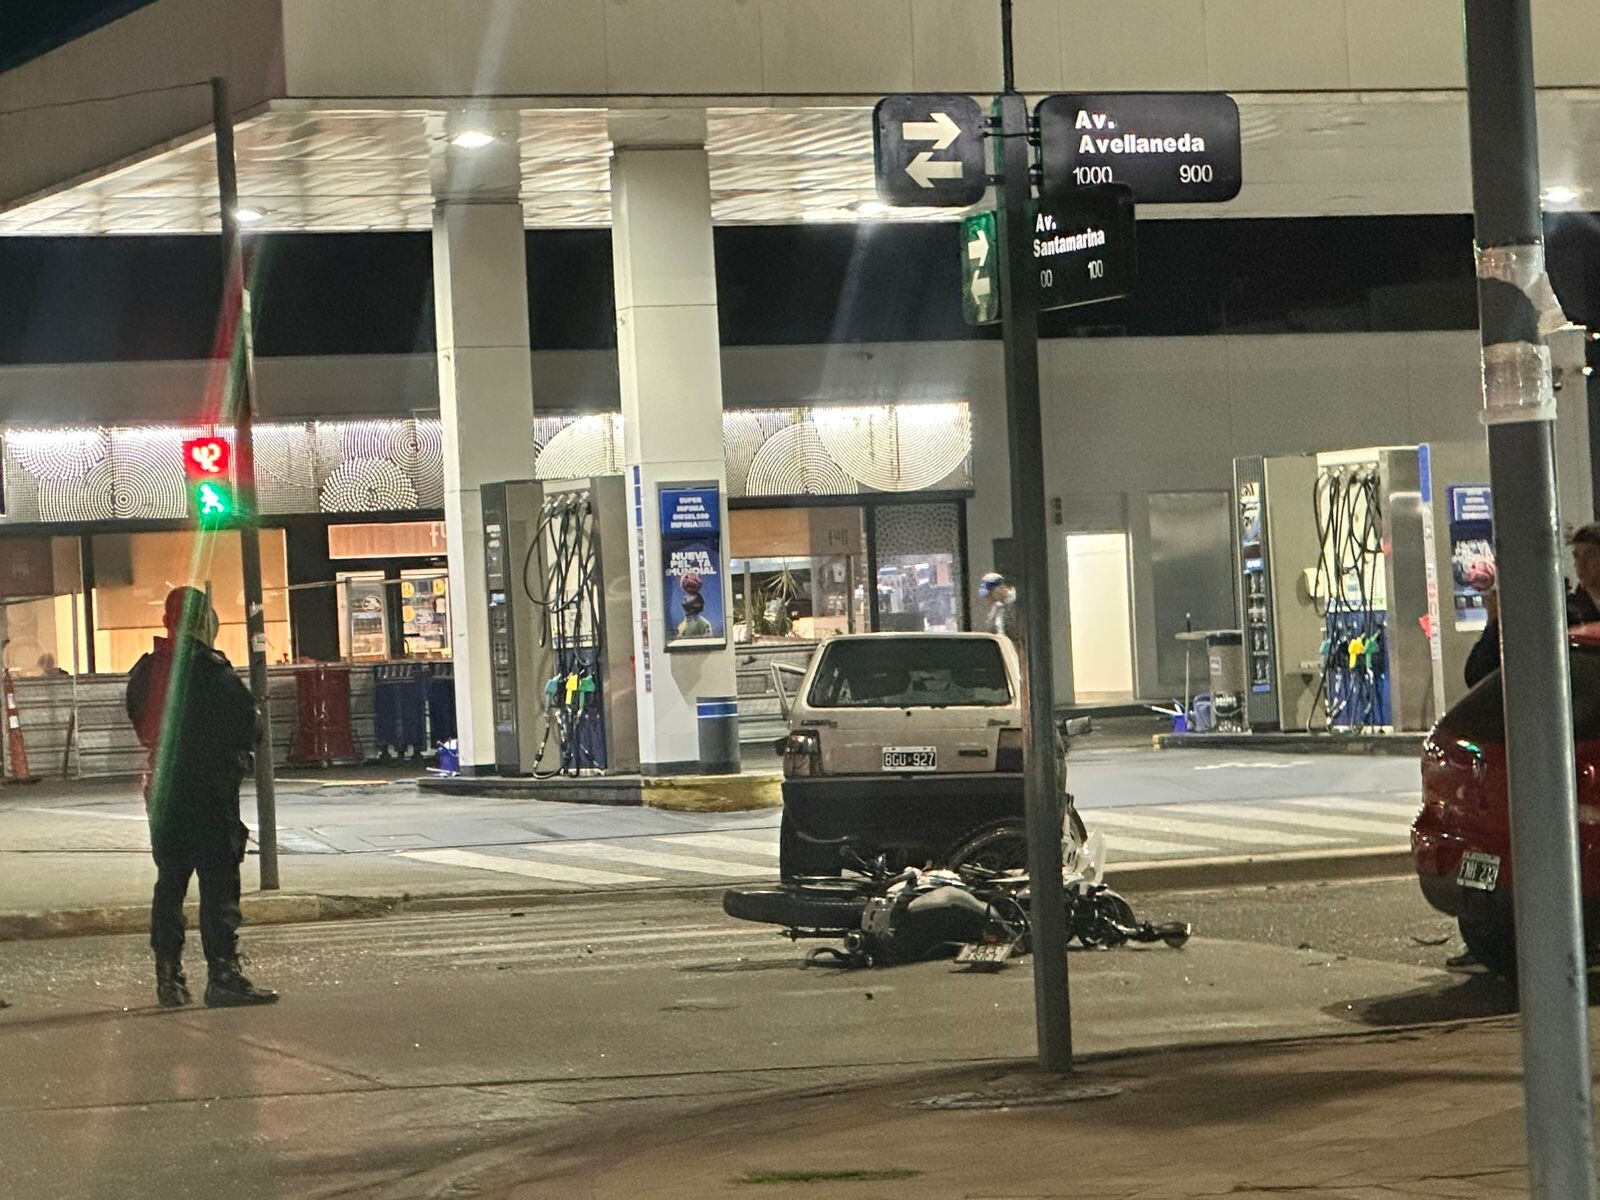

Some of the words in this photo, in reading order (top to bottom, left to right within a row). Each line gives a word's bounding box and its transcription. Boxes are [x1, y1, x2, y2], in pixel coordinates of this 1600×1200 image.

[1075, 110, 1115, 129] Av.
[1079, 133, 1205, 154] Avellaneda
[1073, 166, 1113, 185] 1000
[1179, 164, 1213, 183] 900
[1035, 213, 1057, 233] Av.
[1033, 227, 1105, 258] Santamarina
[1087, 259, 1103, 279] 100
[671, 551, 709, 561] NUEVA
[913, 752, 934, 766] 927
